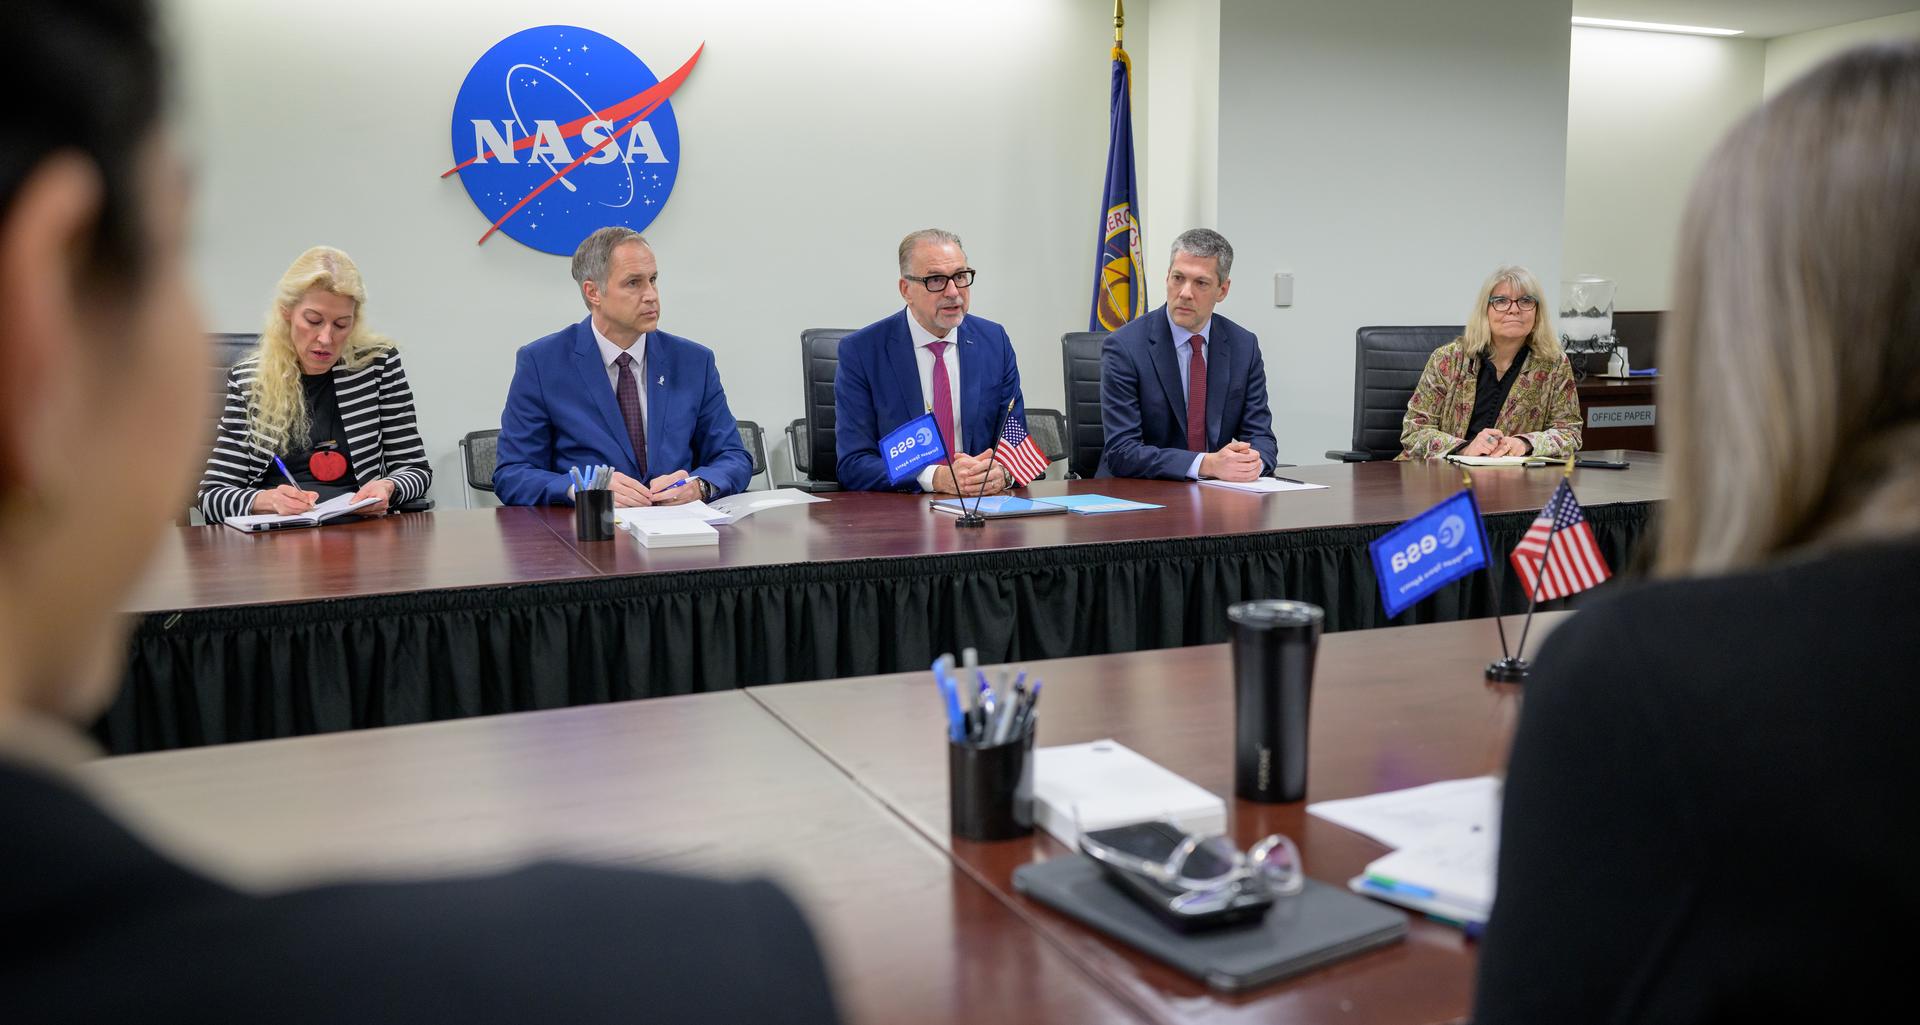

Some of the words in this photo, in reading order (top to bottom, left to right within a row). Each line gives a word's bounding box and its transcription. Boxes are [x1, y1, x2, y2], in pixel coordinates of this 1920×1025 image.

[470, 119, 670, 165] NASA
[1592, 412, 1622, 422] OFFICE
[1624, 411, 1651, 420] PAPER
